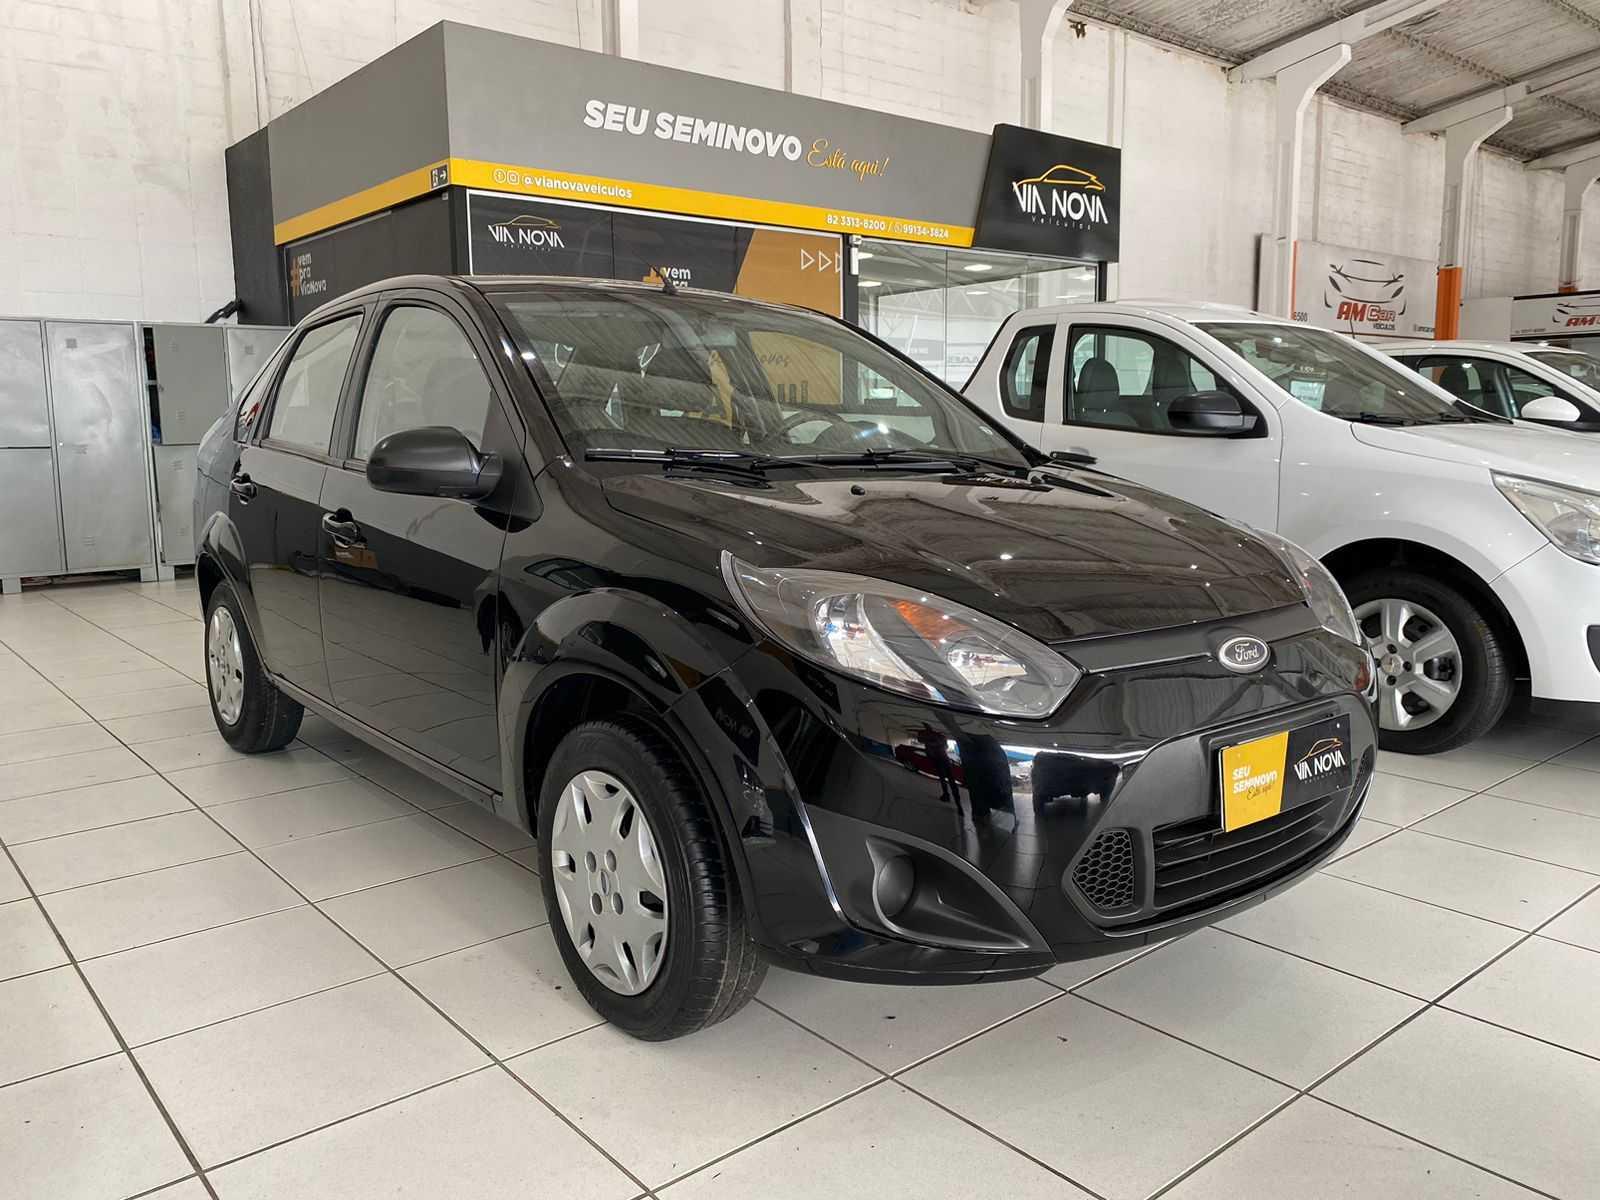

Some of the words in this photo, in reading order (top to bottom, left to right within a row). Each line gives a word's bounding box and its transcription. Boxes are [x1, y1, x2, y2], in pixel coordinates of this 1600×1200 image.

[583, 99, 650, 136] SEU
[654, 112, 803, 162] SEMINOVO
[1012, 181, 1047, 215] VIA
[1051, 188, 1109, 225] NOVA
[487, 224, 515, 244] VIA
[519, 228, 565, 249] NOVA
[662, 267, 692, 280] vem
[1336, 301, 1368, 322] AM
[1234, 642, 1259, 662] Ford
[1232, 765, 1251, 781] SEU
[1294, 762, 1312, 781] VIA
[1313, 749, 1346, 775] NOVA
